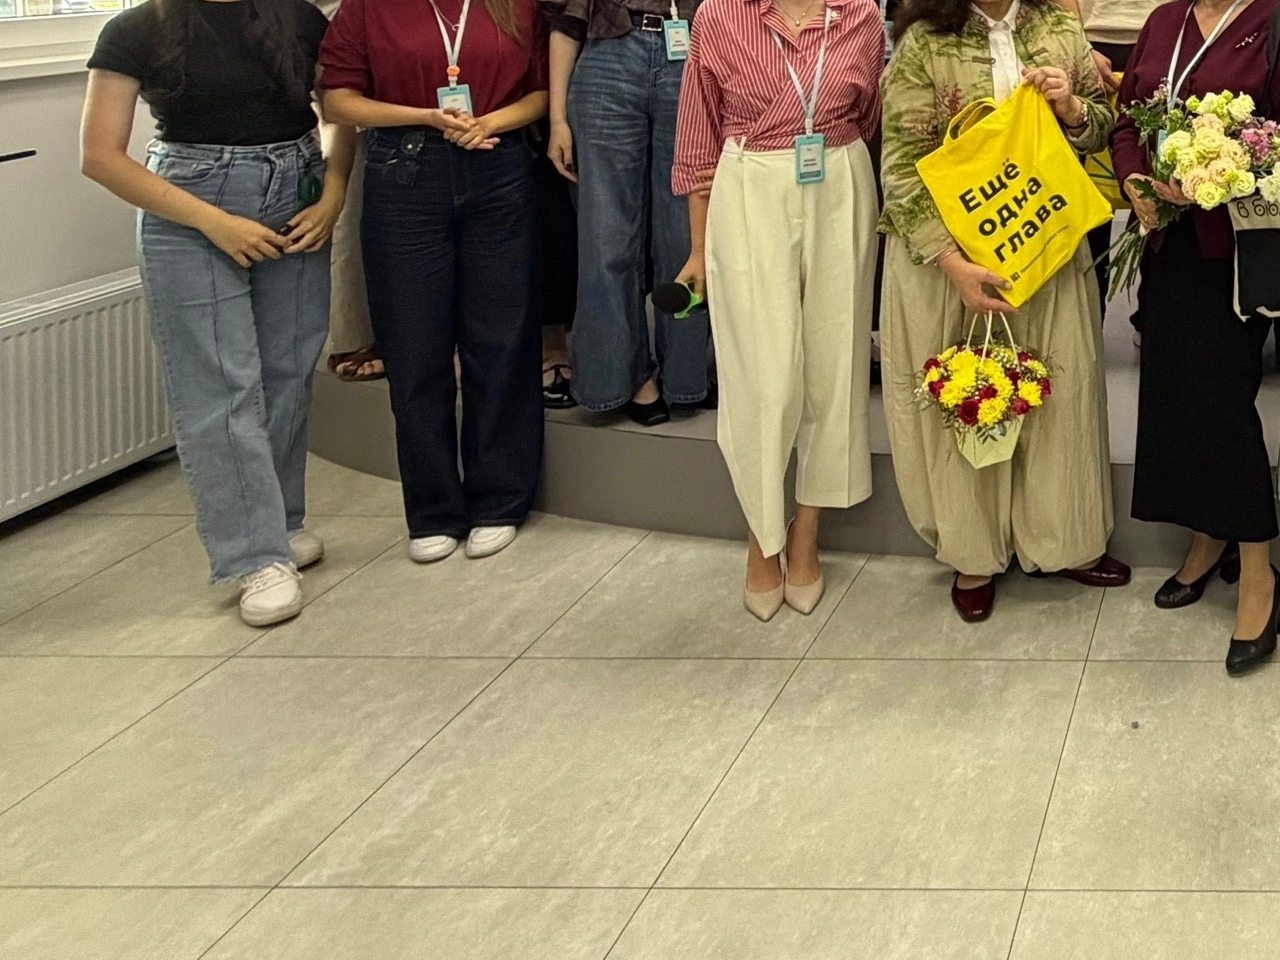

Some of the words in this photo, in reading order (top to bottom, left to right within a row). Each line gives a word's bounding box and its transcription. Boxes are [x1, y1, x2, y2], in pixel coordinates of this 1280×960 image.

[958, 157, 1021, 214] Ещё
[978, 176, 1043, 236] одна
[993, 194, 1068, 263] глава
